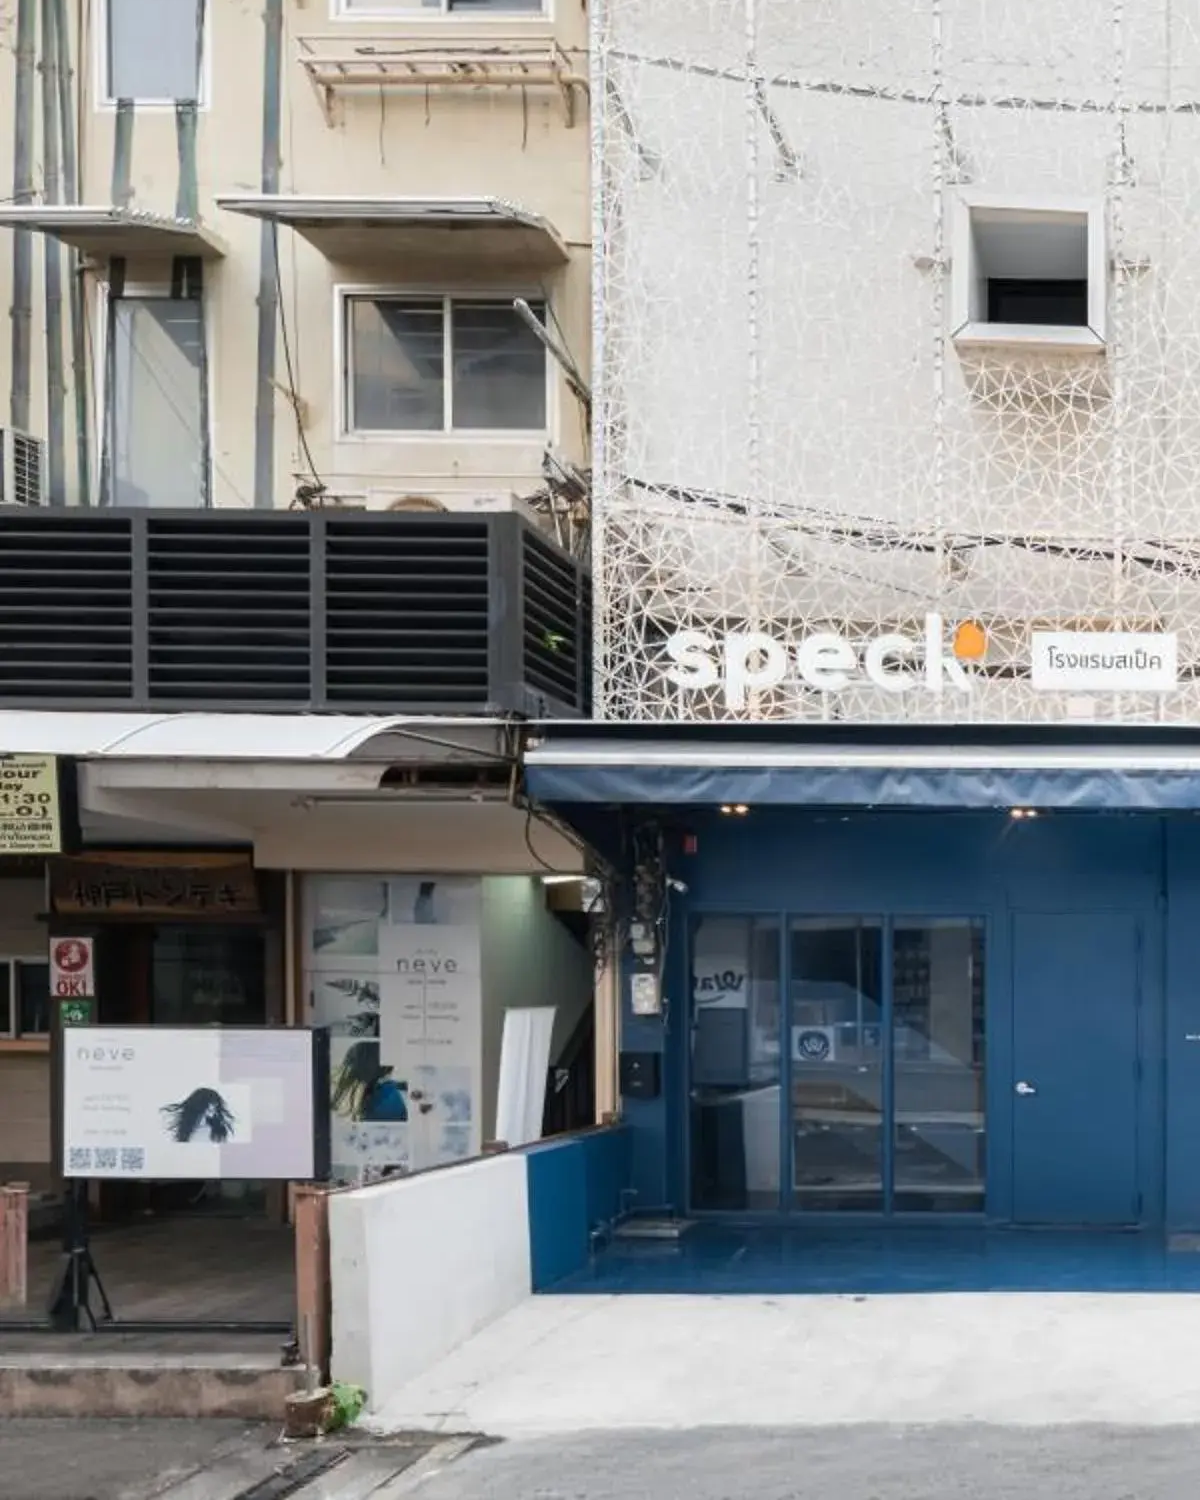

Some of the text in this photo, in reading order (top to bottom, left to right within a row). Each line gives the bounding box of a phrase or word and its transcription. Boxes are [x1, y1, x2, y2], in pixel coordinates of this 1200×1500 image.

[665, 612, 987, 710] speck
[0, 770, 42, 779] our
[396, 958, 458, 973] neve
[77, 1047, 135, 1061] neve
